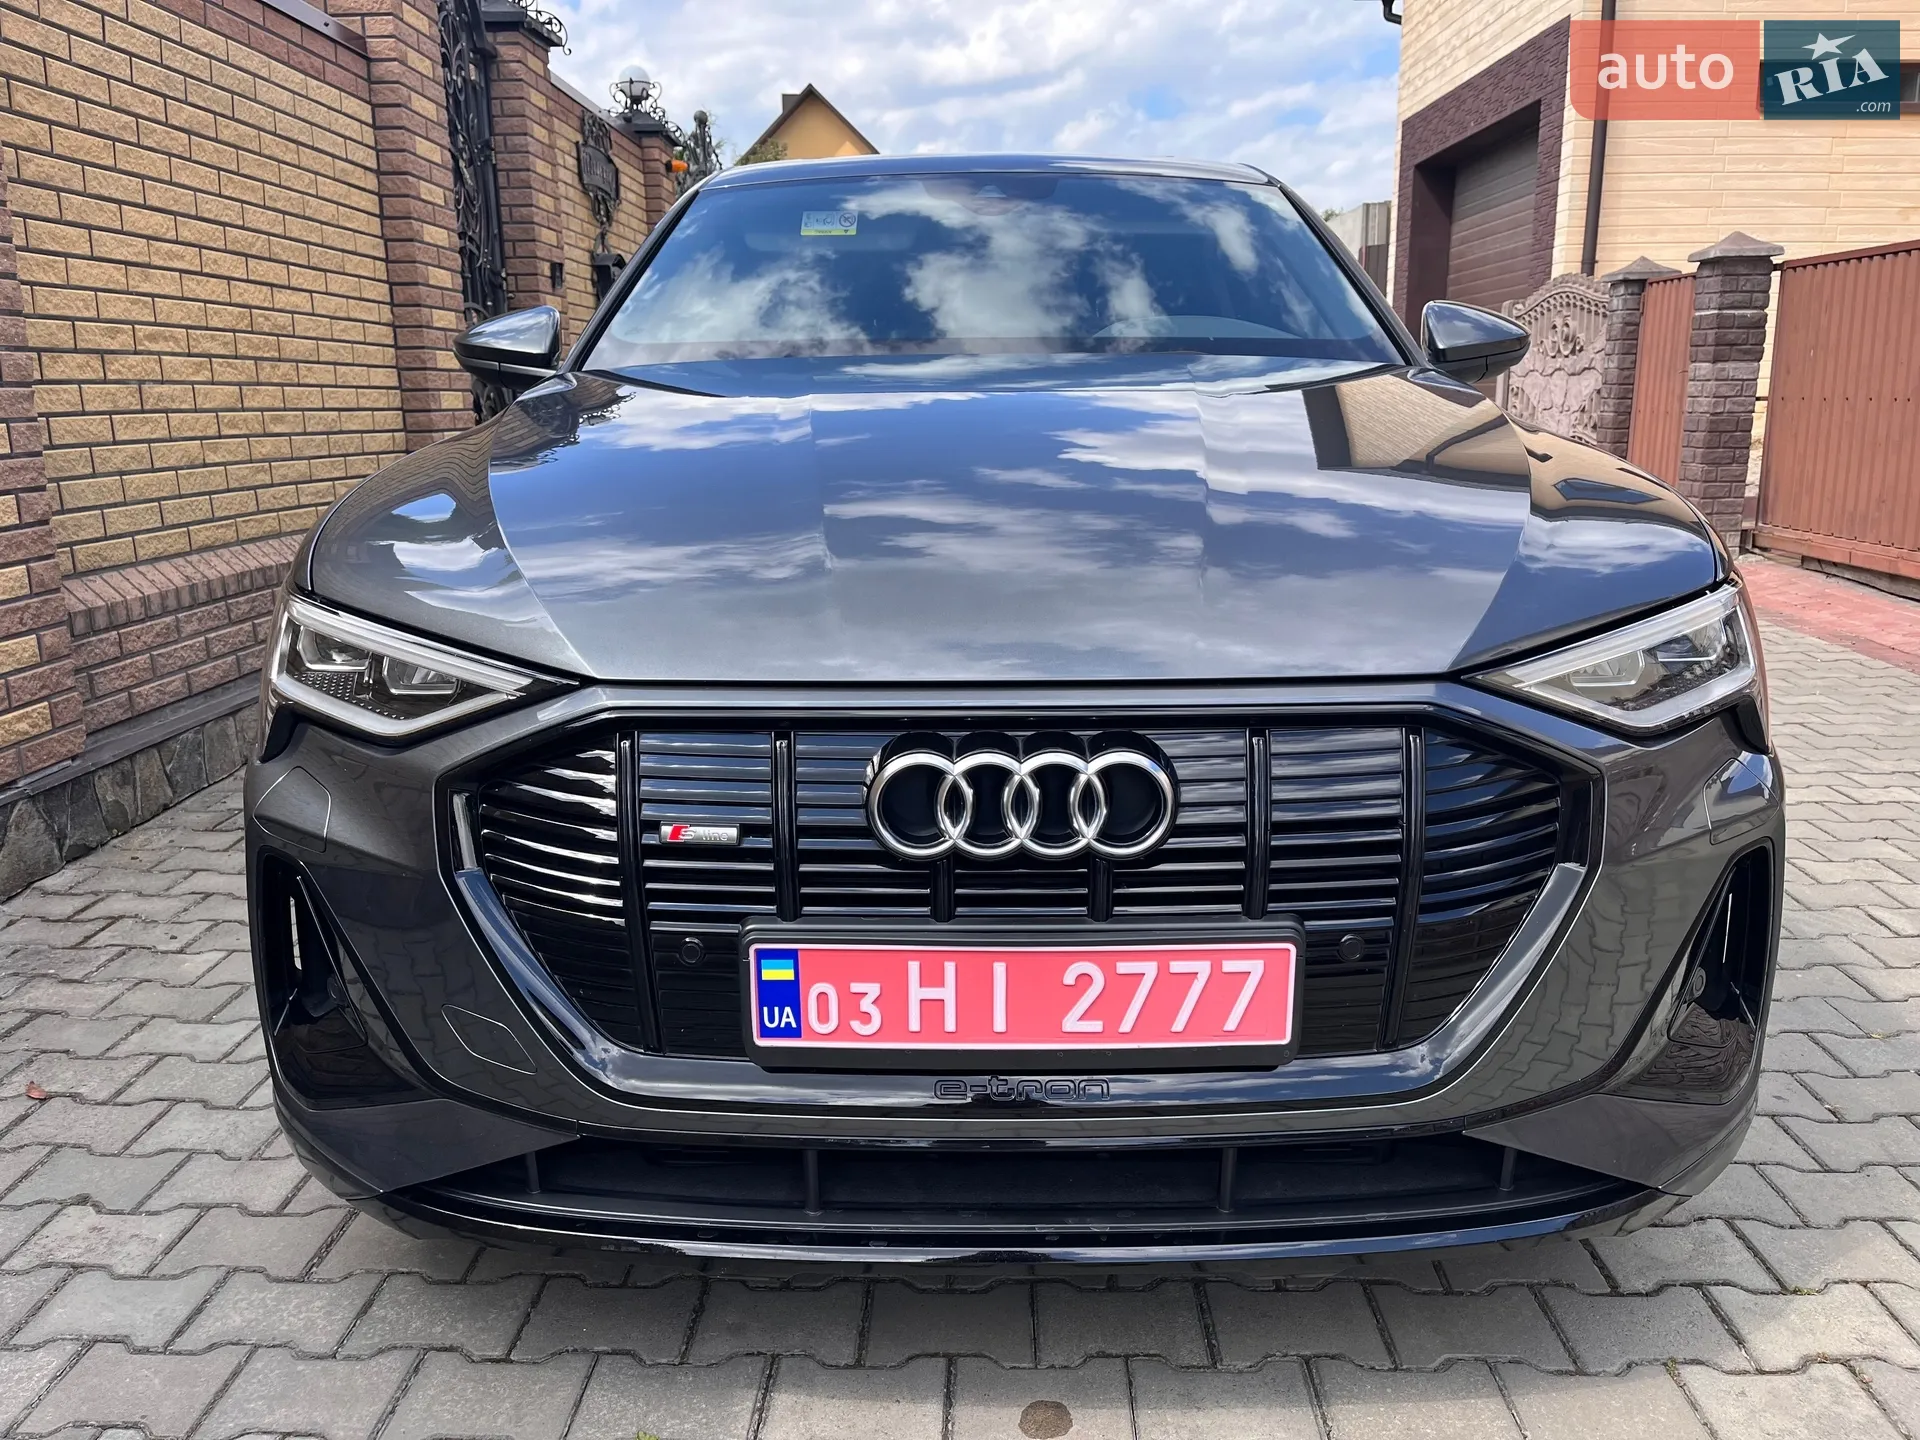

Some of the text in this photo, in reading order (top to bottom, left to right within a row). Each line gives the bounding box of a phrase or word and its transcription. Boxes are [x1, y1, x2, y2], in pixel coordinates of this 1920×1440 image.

[702, 829, 729, 841] line
[807, 983, 882, 1036] 03
[1062, 960, 1265, 1033] 2777
[763, 1006, 797, 1029] UA
[934, 1075, 1110, 1101] e-tron
